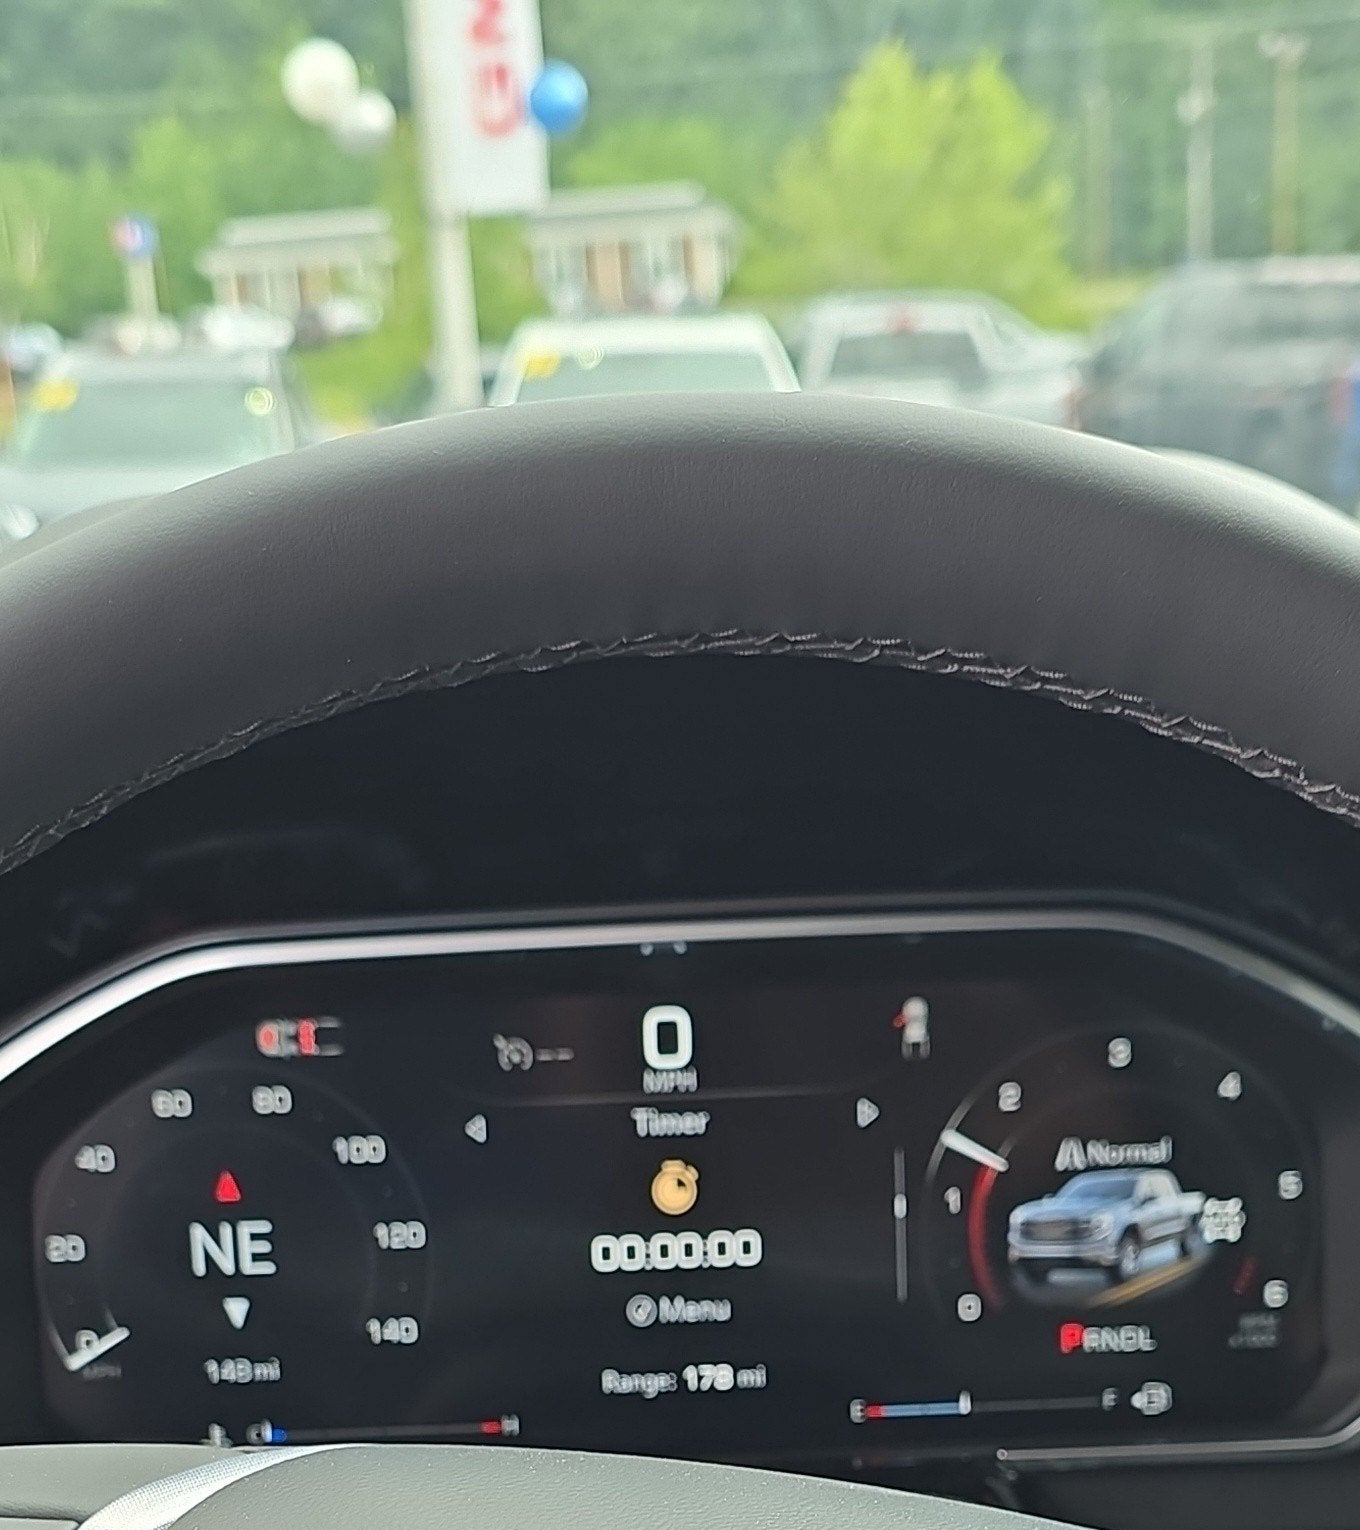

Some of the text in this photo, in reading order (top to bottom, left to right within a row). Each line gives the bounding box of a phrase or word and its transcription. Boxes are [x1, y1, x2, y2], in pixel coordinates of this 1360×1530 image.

[643, 1005, 693, 1070] 0
[643, 1067, 698, 1094] MPH
[998, 1082, 1022, 1111] 2
[631, 1106, 711, 1138] Timer
[75, 1144, 116, 1173] 40
[333, 1134, 386, 1164] 100
[1087, 1135, 1172, 1167] Normal
[189, 1219, 277, 1277] NE
[373, 1220, 426, 1250] 120
[591, 1229, 762, 1272] 00:00:00
[659, 1295, 732, 1324] Menu
[365, 1316, 419, 1344] 140
[601, 1369, 678, 1399] Range:
[737, 1364, 767, 1389] mi
